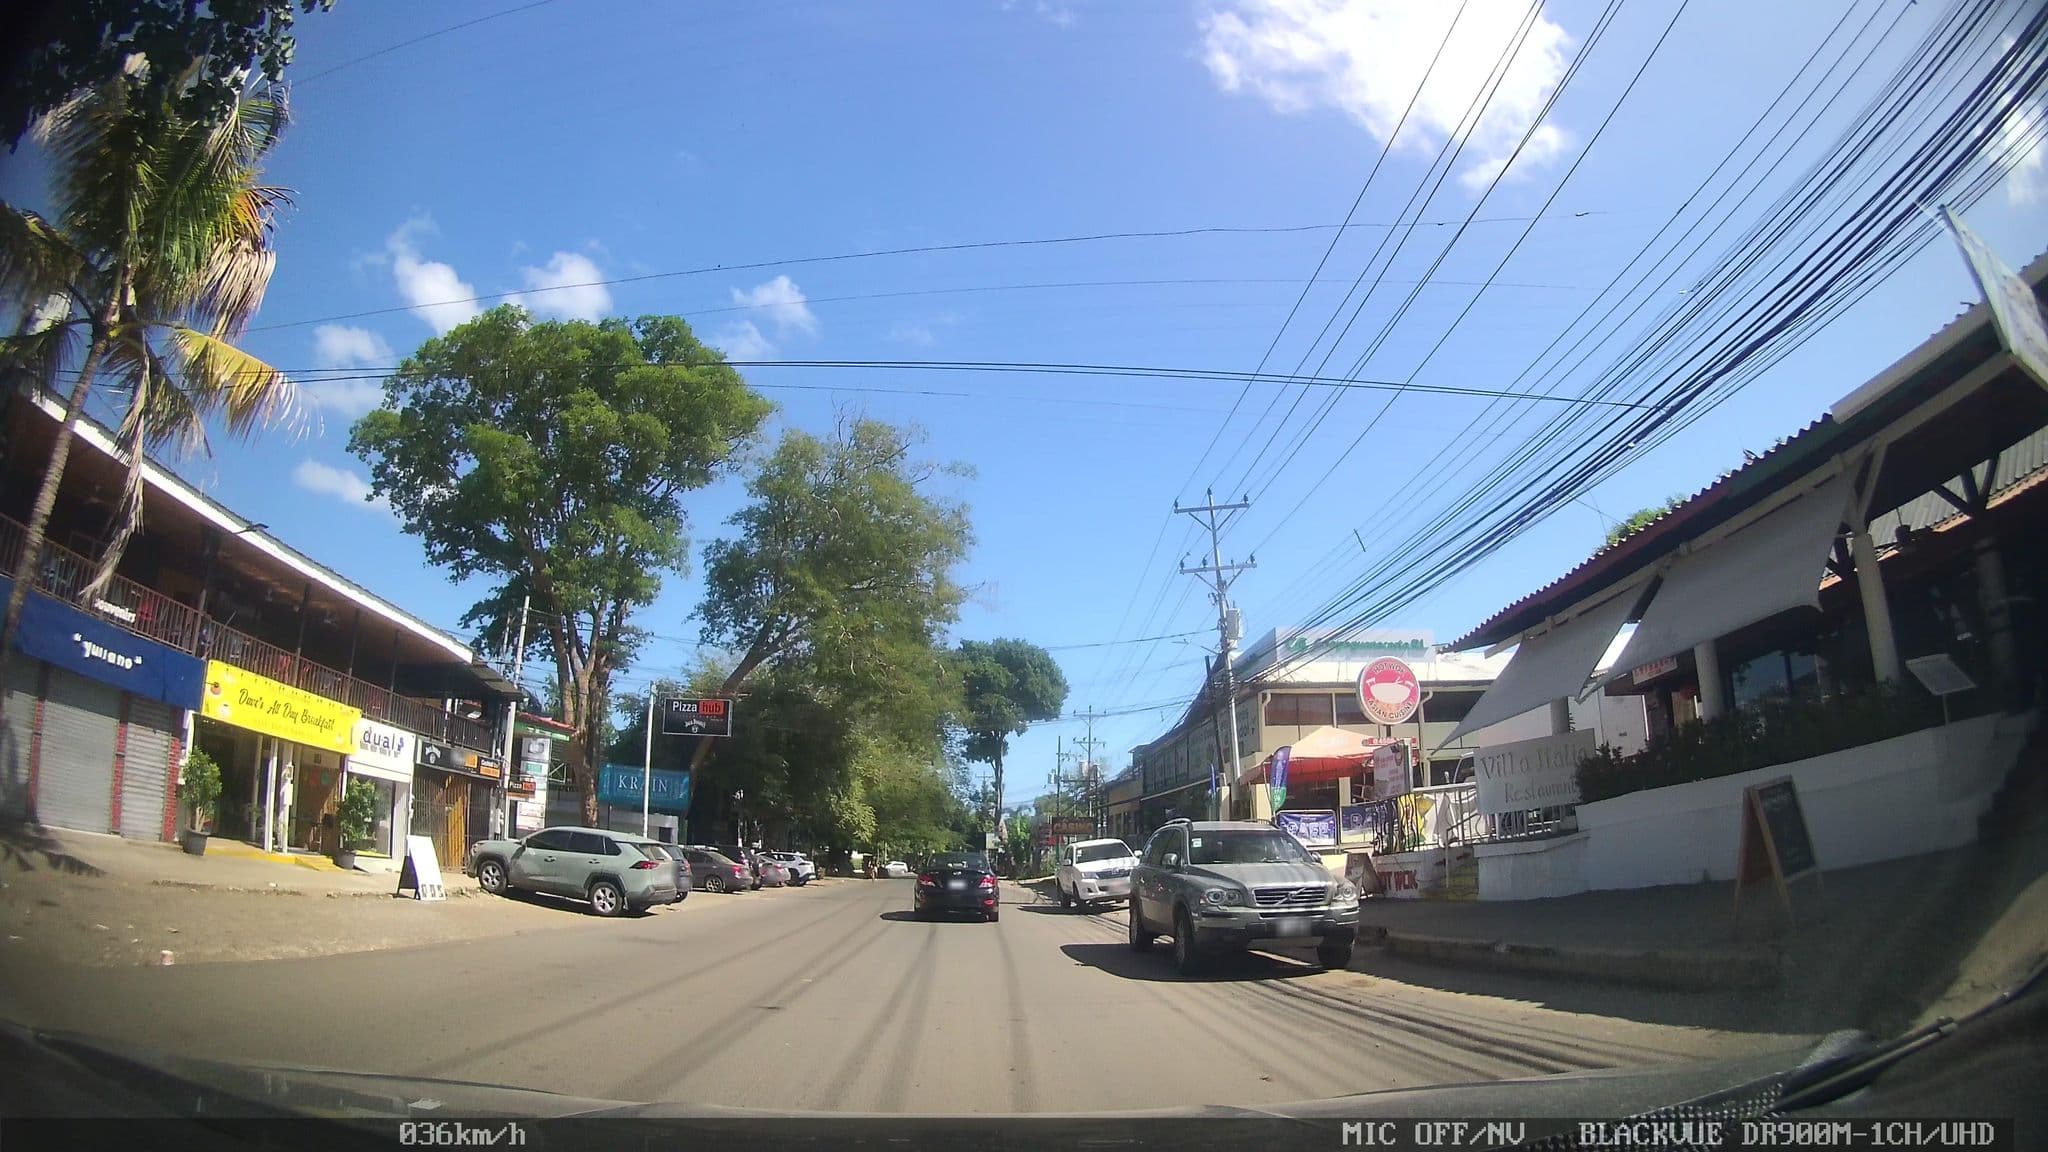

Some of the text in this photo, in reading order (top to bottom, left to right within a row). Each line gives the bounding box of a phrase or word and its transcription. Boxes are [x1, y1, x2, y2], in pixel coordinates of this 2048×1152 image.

[239, 688, 264, 710] Dave's
[267, 700, 282, 715] All
[283, 703, 299, 724] Day
[301, 708, 335, 733] Breakfast
[672, 700, 721, 713] Pizza hub
[1480, 752, 1529, 779] Villa
[619, 774, 668, 793] KRIN
